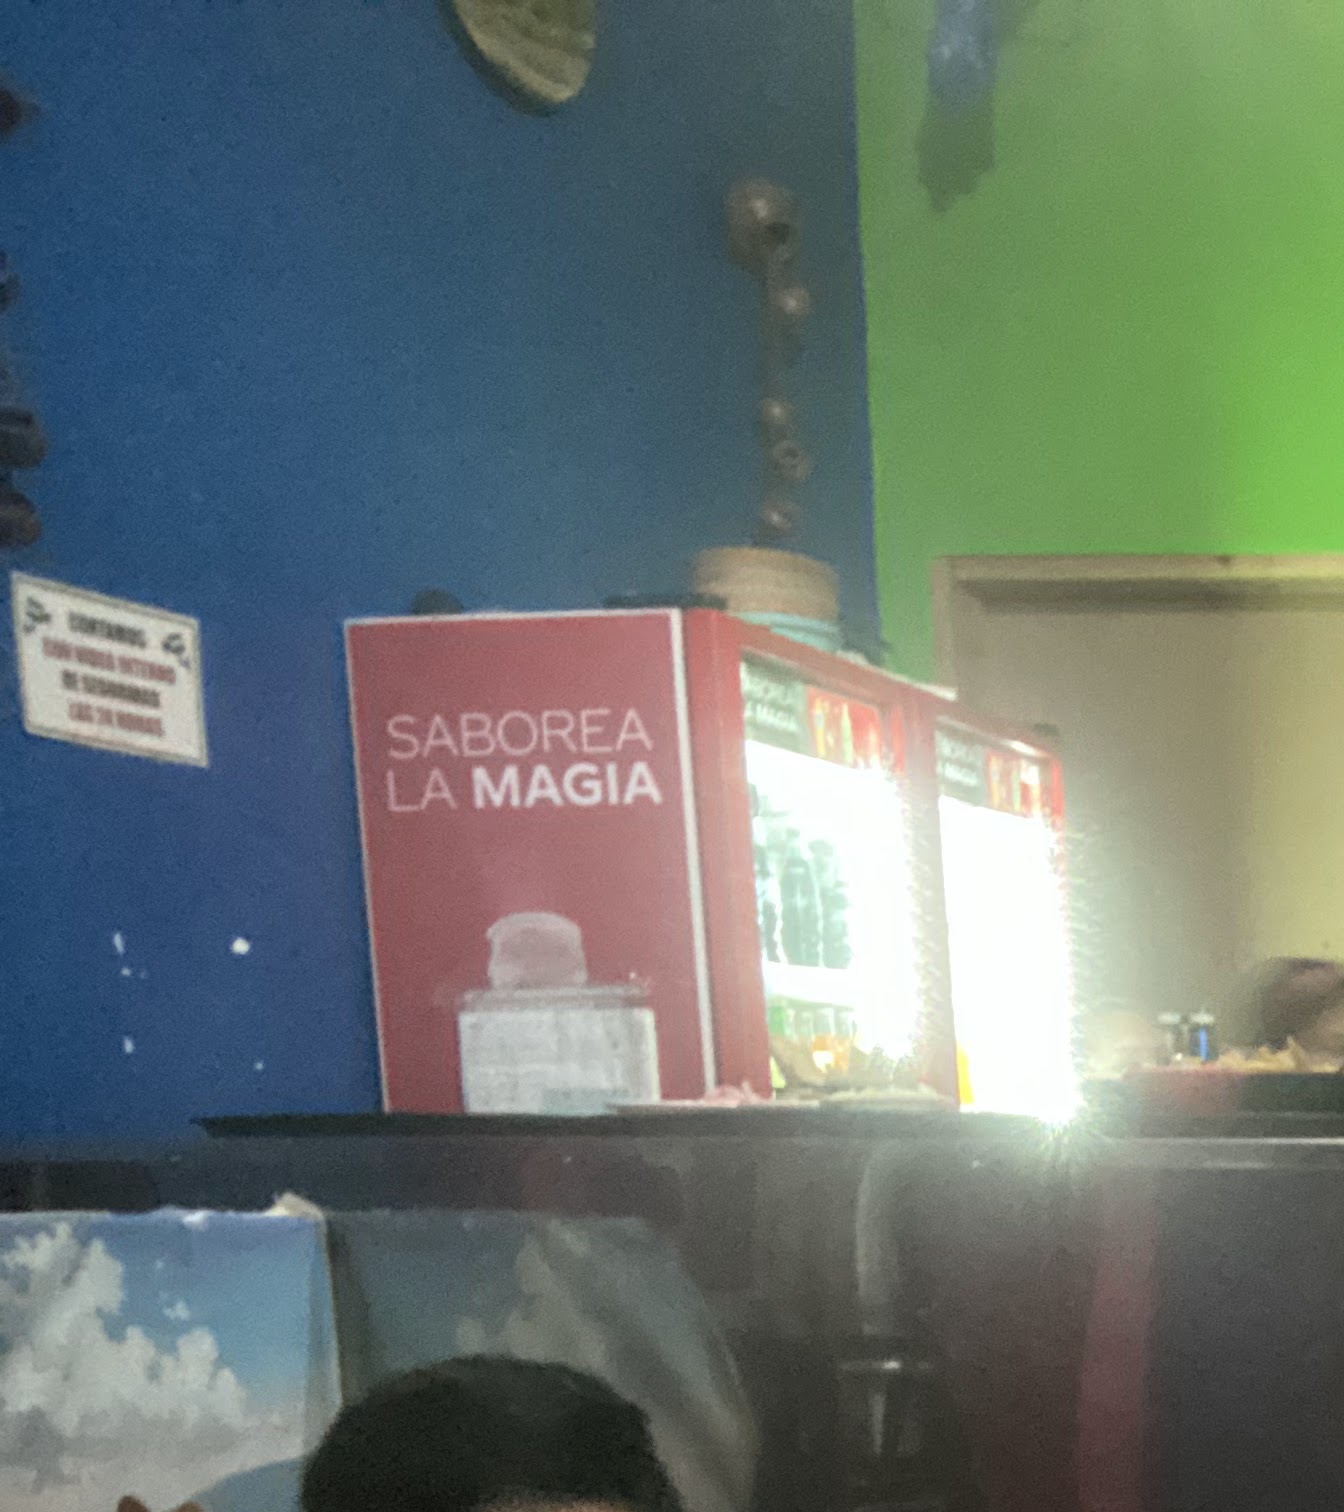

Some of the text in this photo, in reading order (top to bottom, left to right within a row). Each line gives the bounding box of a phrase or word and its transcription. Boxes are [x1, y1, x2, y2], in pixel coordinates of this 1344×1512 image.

[387, 708, 654, 760] SABOREA
[386, 761, 663, 813] LA MAGIA
